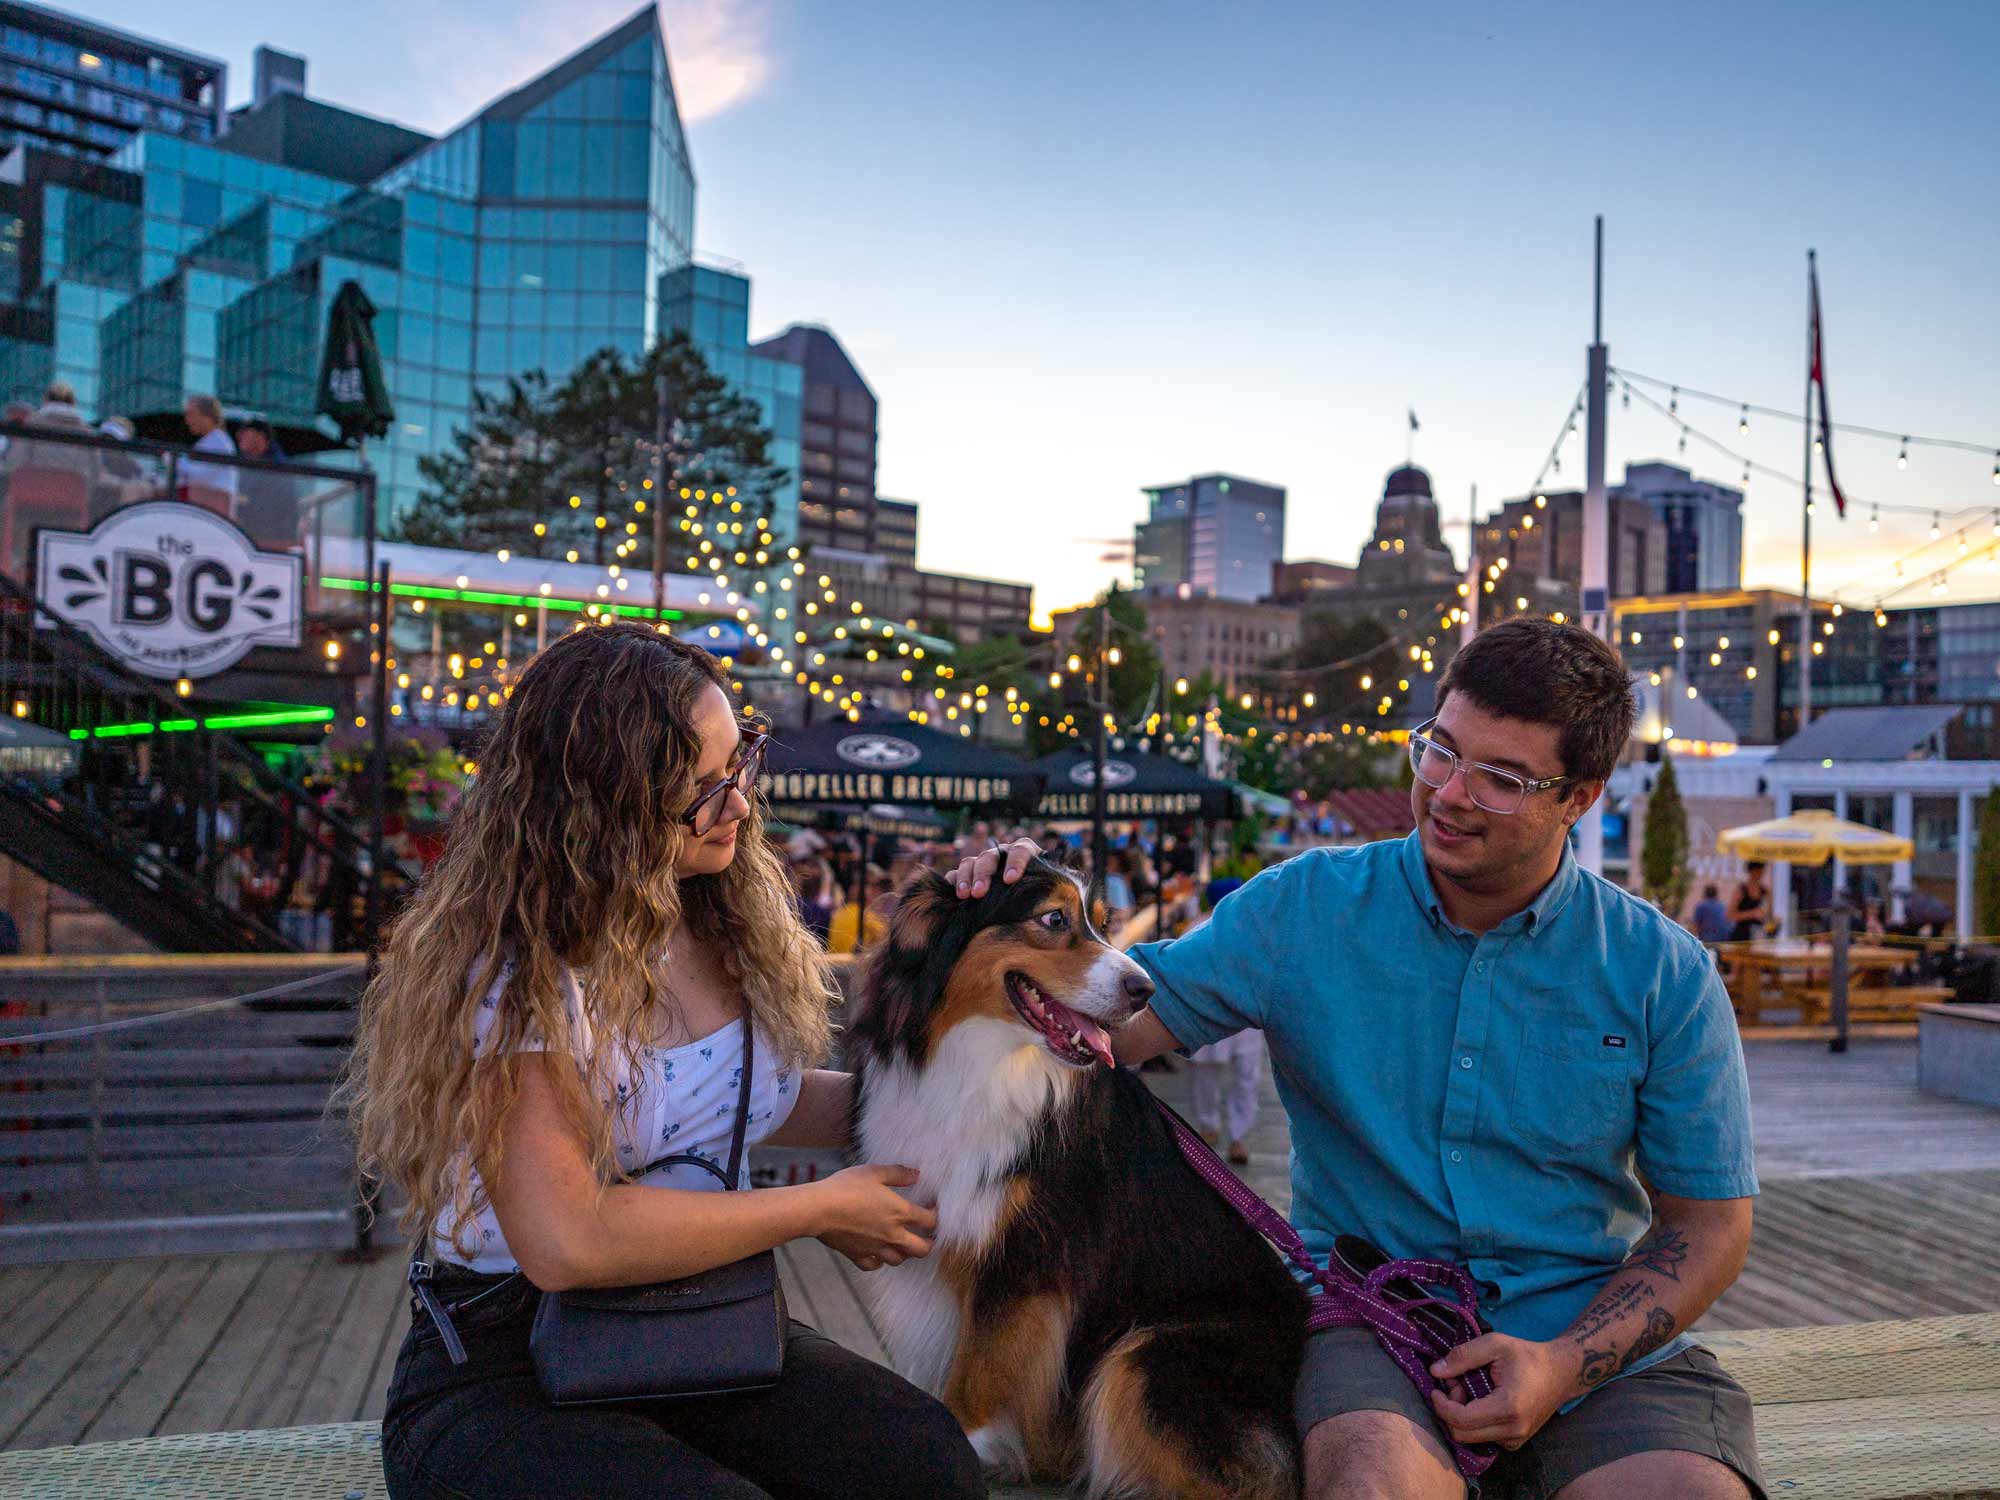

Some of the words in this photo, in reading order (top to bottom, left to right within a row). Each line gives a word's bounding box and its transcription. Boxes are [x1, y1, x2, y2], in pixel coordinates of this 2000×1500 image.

[157, 533, 194, 555] the
[114, 551, 234, 633] BG
[758, 773, 884, 800] PROPELLER
[892, 775, 991, 802] BREWING
